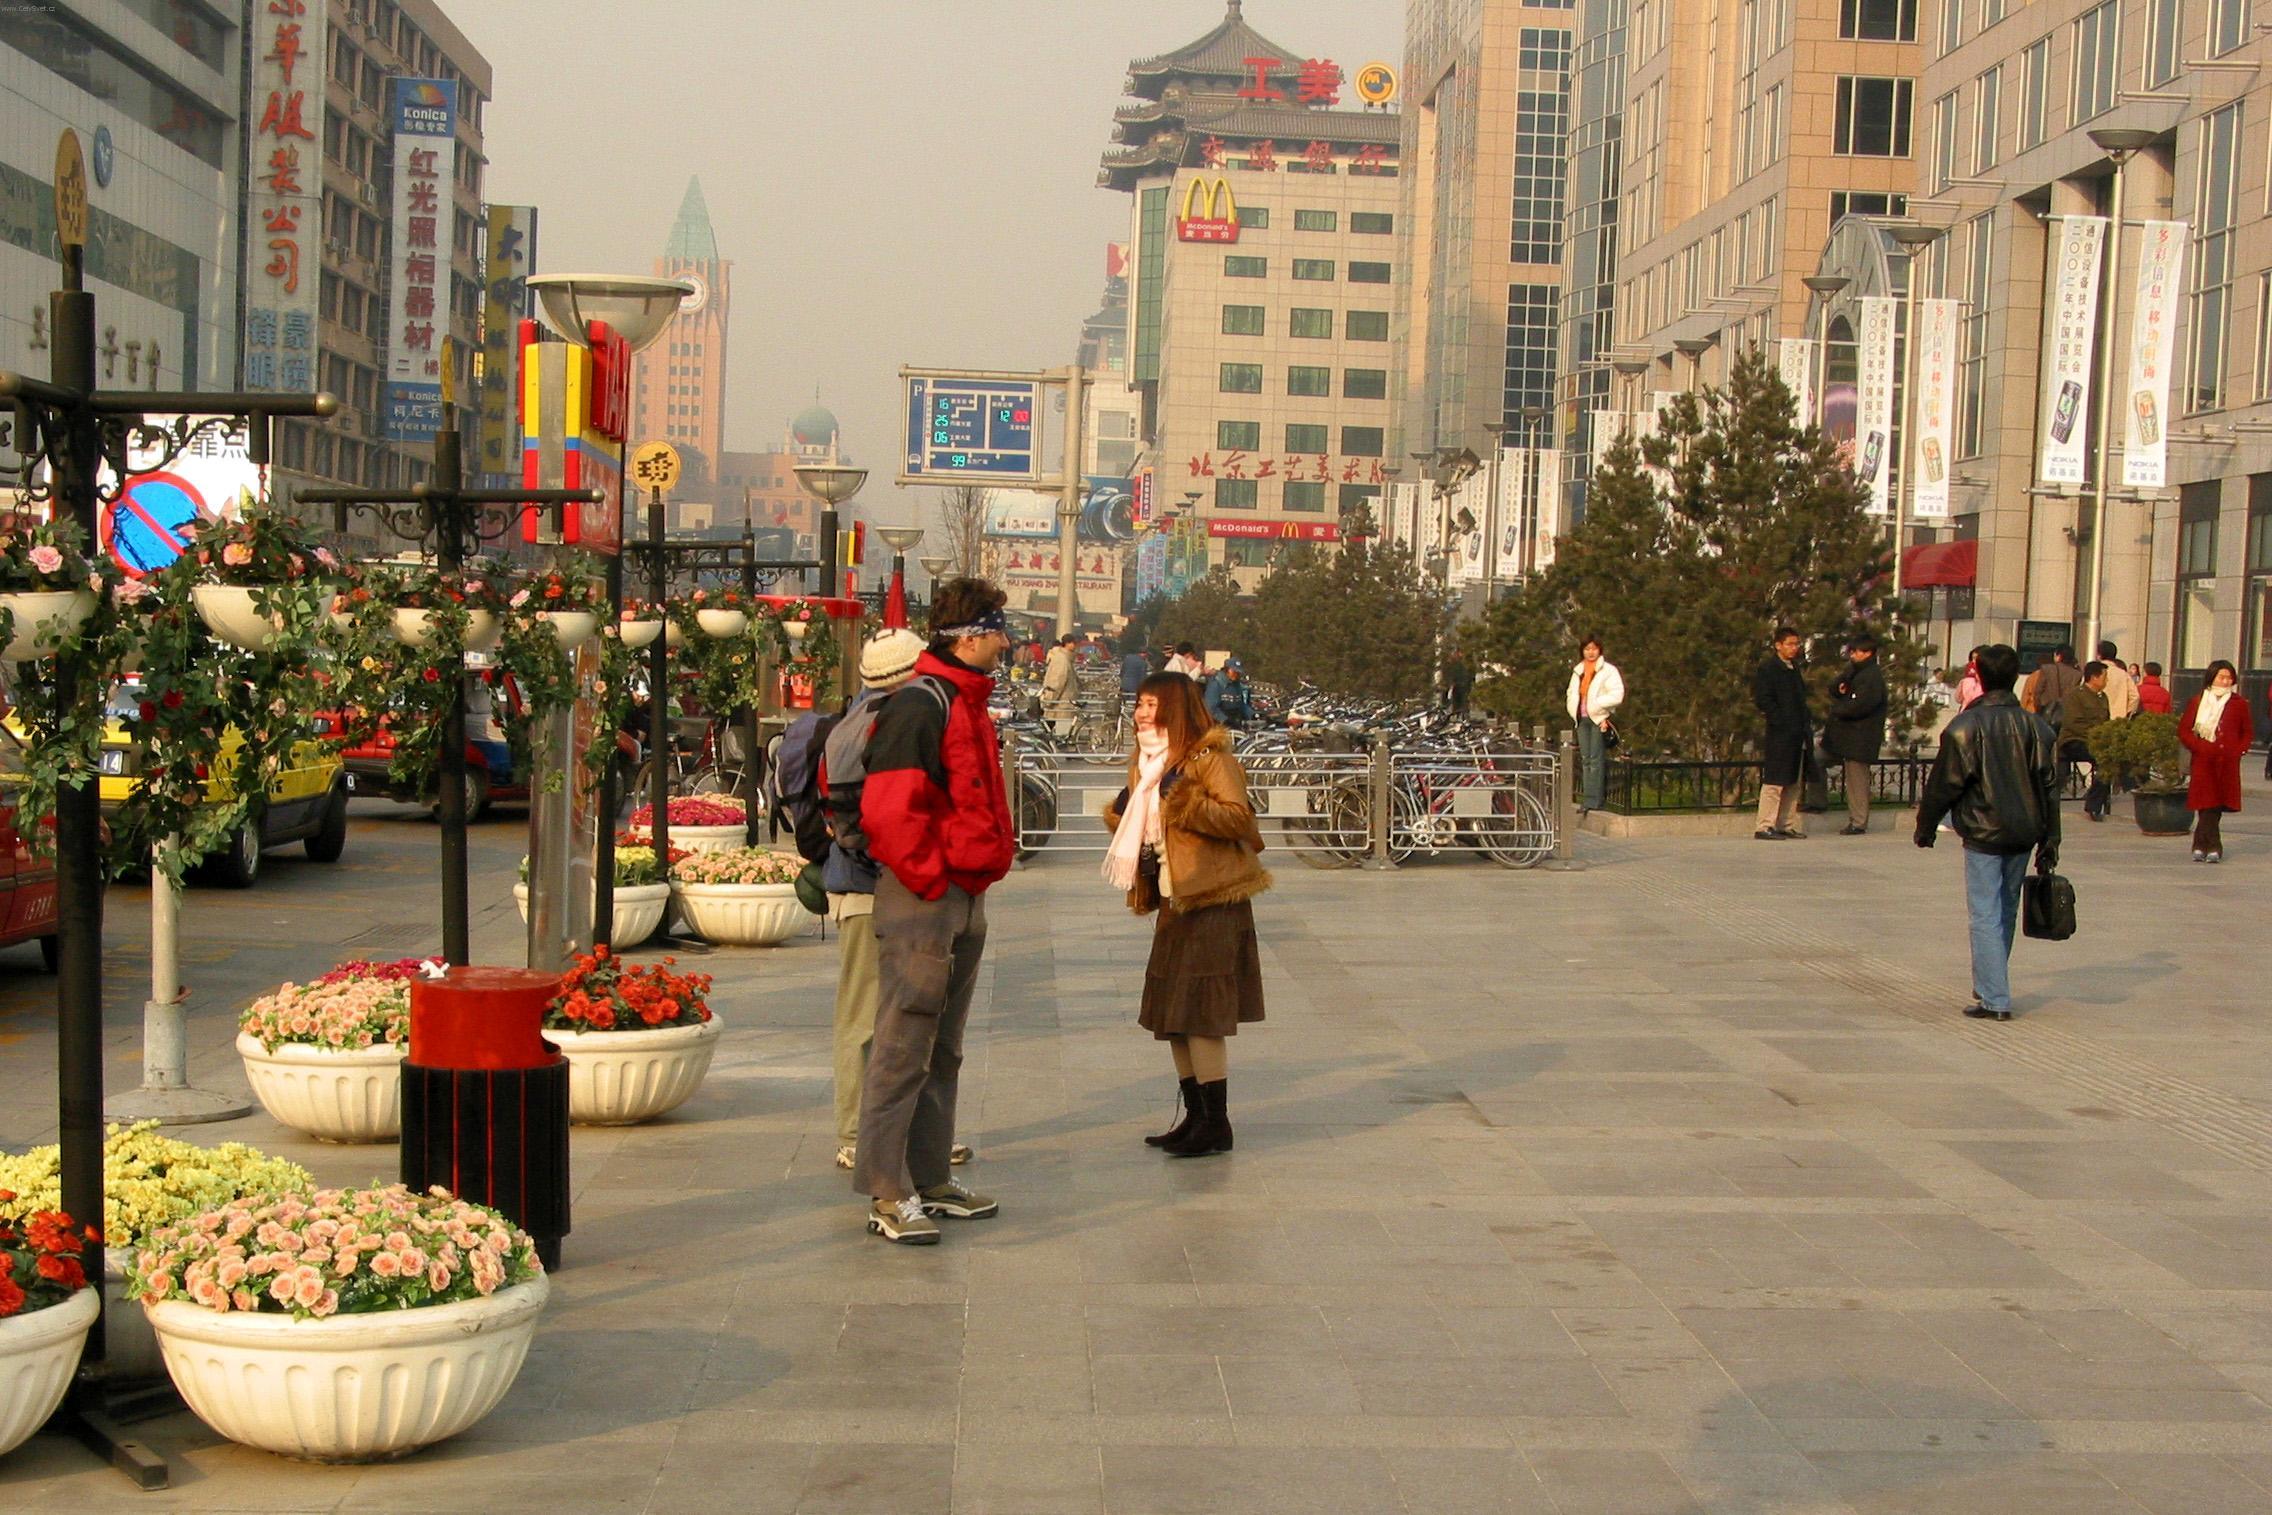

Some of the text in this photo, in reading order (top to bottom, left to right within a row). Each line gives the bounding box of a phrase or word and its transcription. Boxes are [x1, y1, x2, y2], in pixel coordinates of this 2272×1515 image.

[1237, 57, 1341, 105] 工美
[404, 107, 447, 120] Konica
[913, 385, 922, 396] P
[952, 455, 965, 467] 99
[1213, 523, 1269, 533] McDonald's
